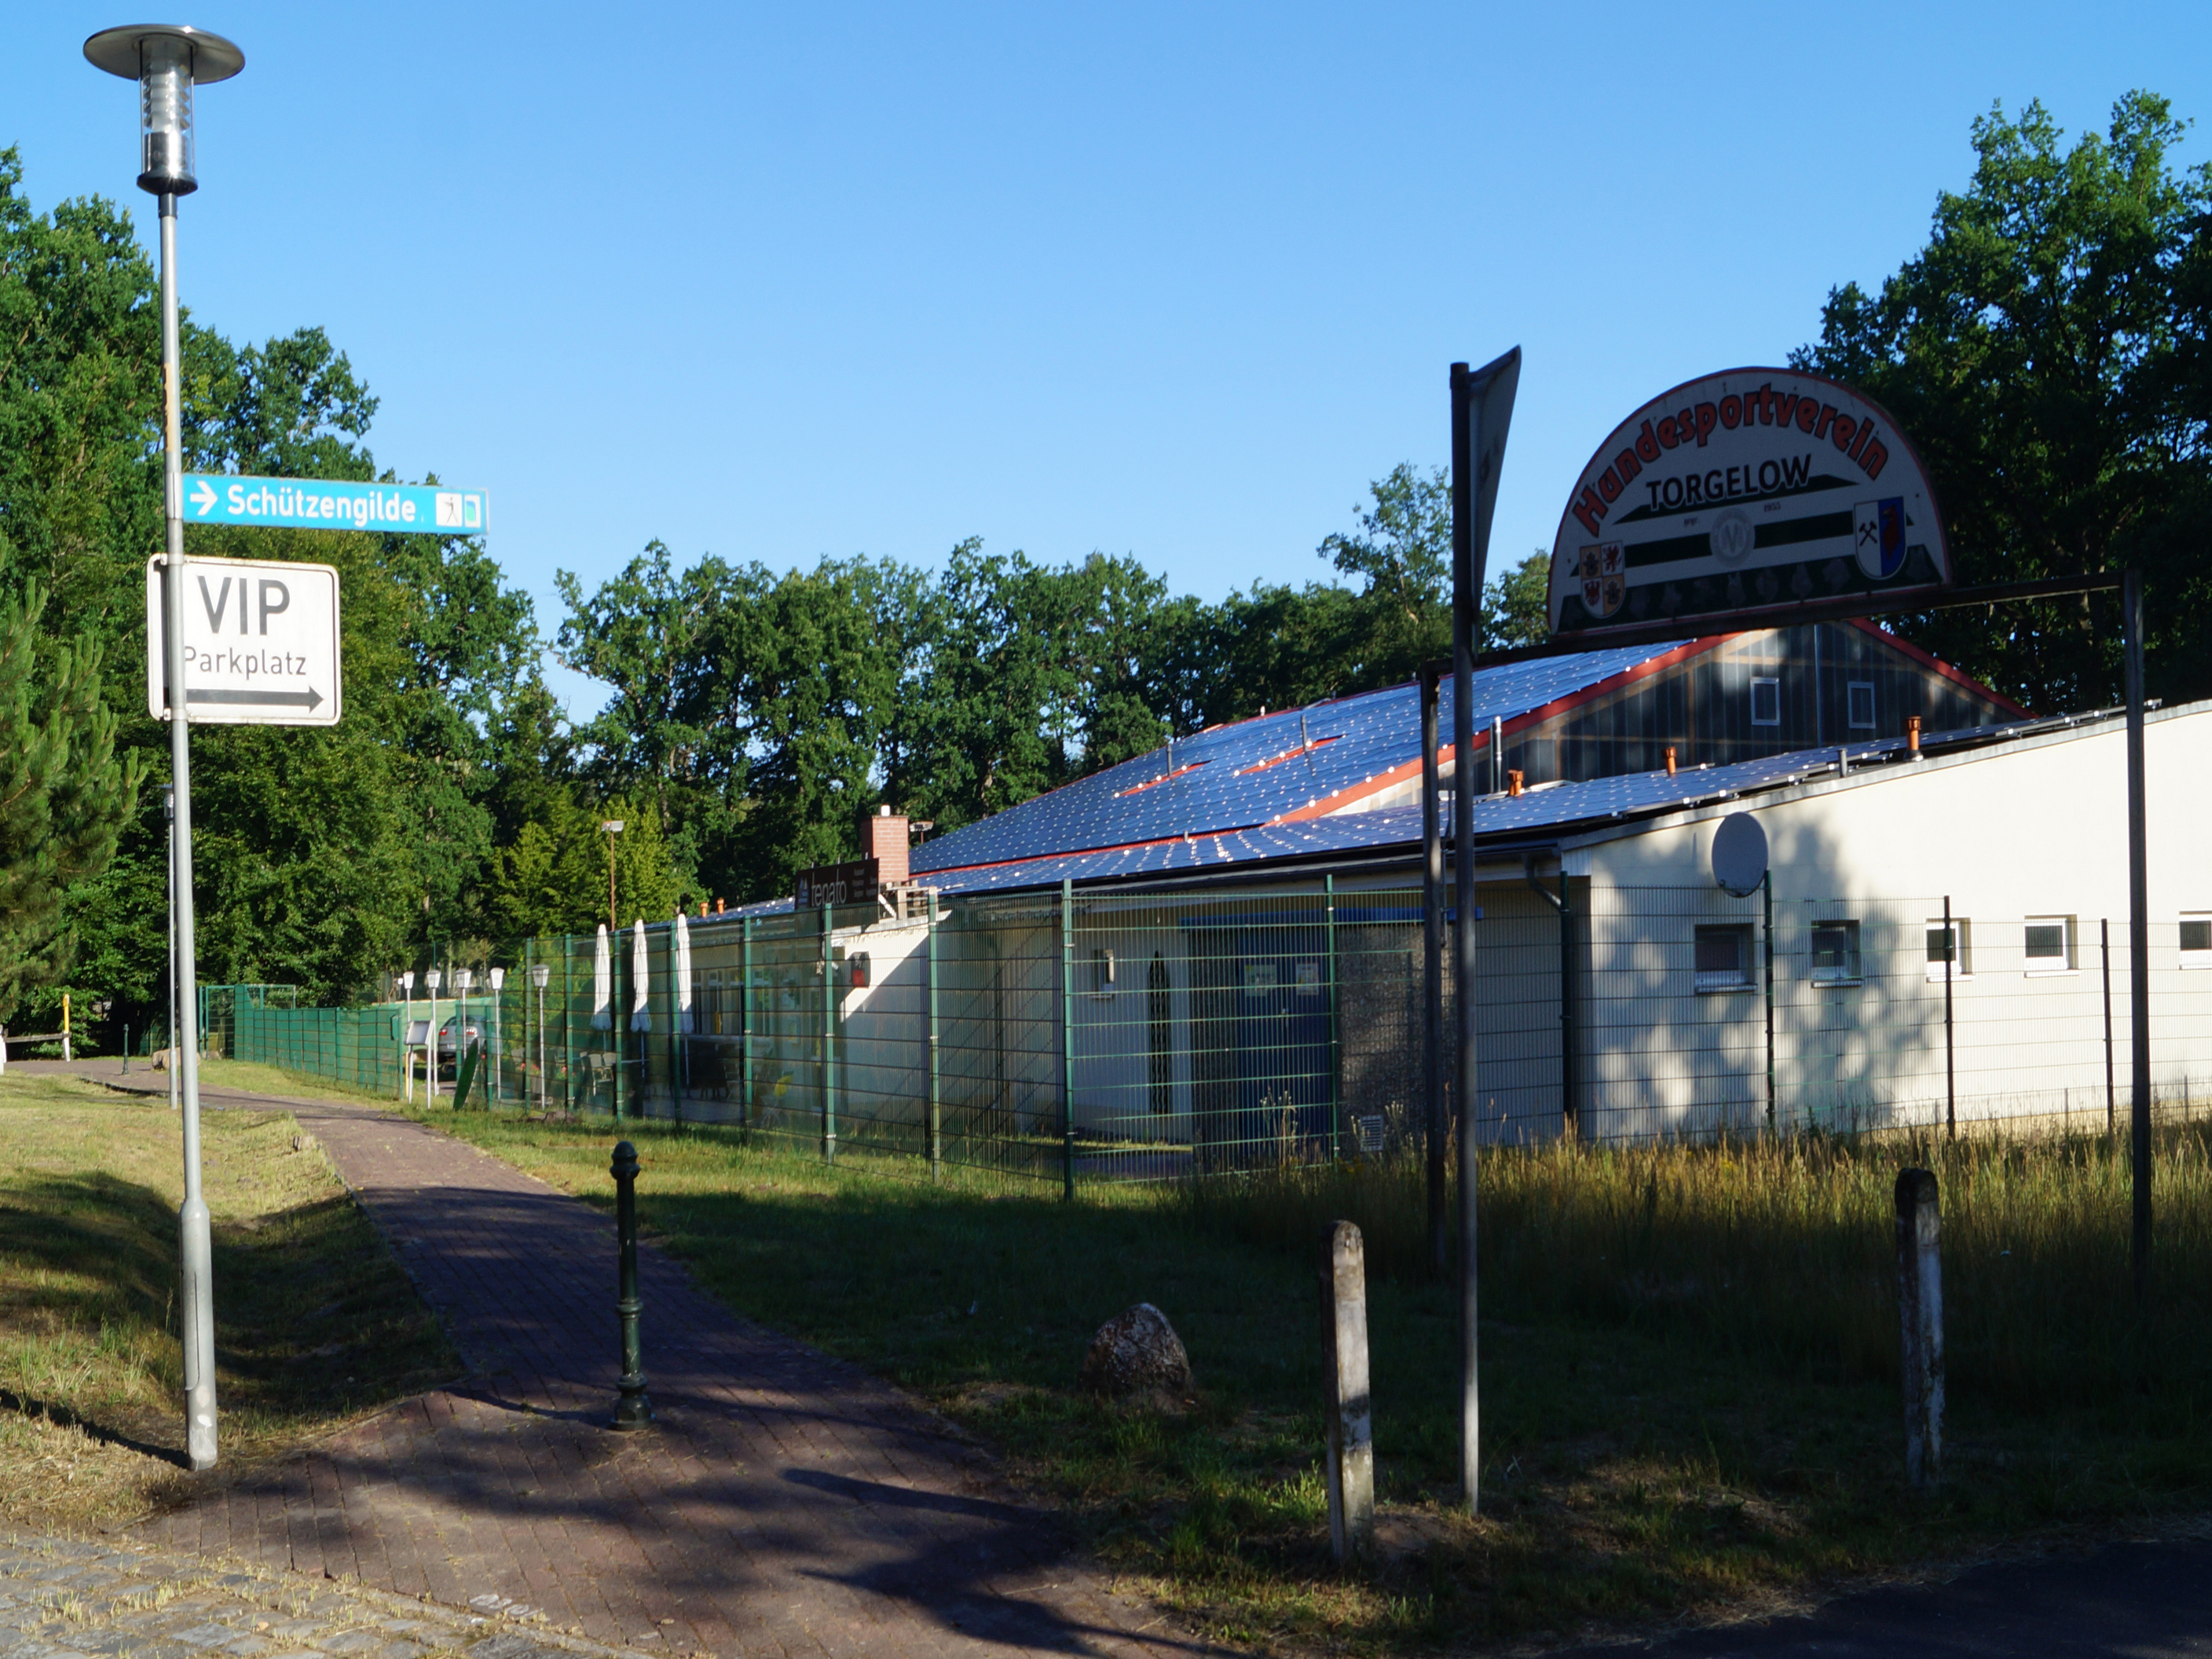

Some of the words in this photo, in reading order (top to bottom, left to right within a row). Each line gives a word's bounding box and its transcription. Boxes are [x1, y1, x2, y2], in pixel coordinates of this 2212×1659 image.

[1572, 383, 1889, 537] Hundesportverein
[1646, 453, 1812, 511] TORGELOW
[227, 484, 416, 527] Schützengilde
[196, 575, 291, 636] VIP
[185, 645, 307, 681] Parkplatz
